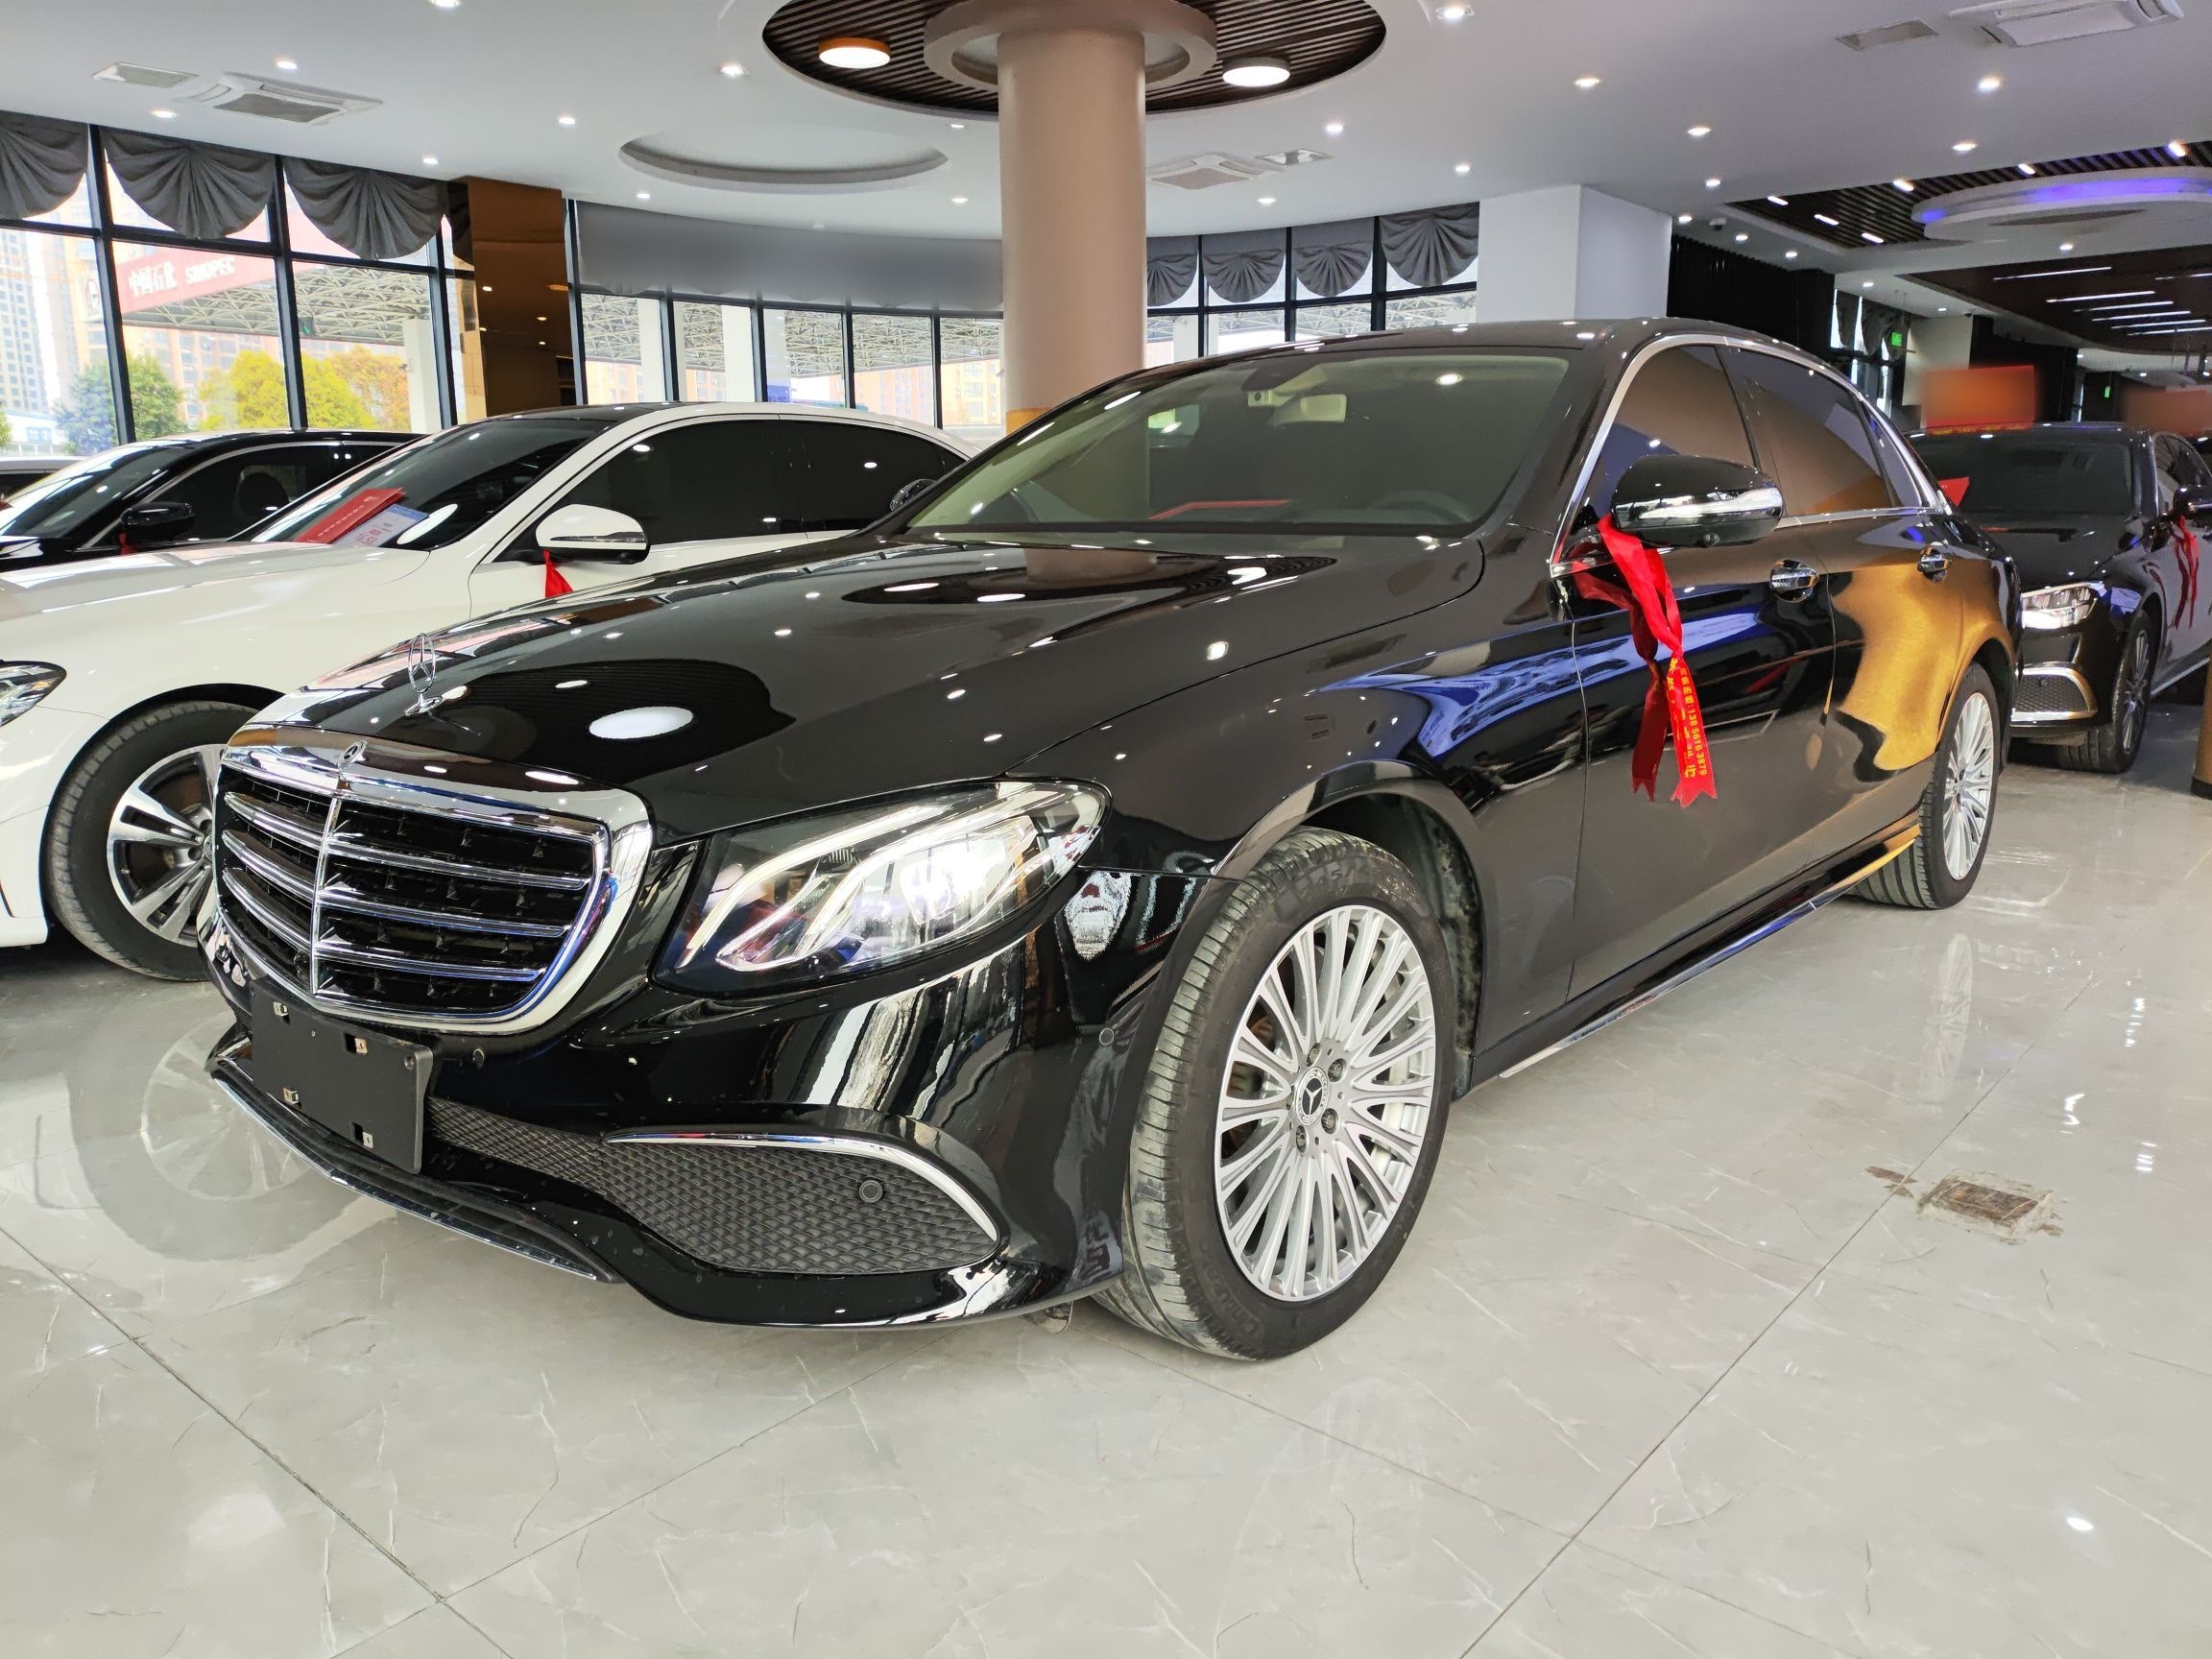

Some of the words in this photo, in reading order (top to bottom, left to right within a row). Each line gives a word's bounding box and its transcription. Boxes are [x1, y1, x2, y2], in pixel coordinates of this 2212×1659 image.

[130, 261, 177, 297] 中国石化
[184, 256, 235, 284] SINOPEC
